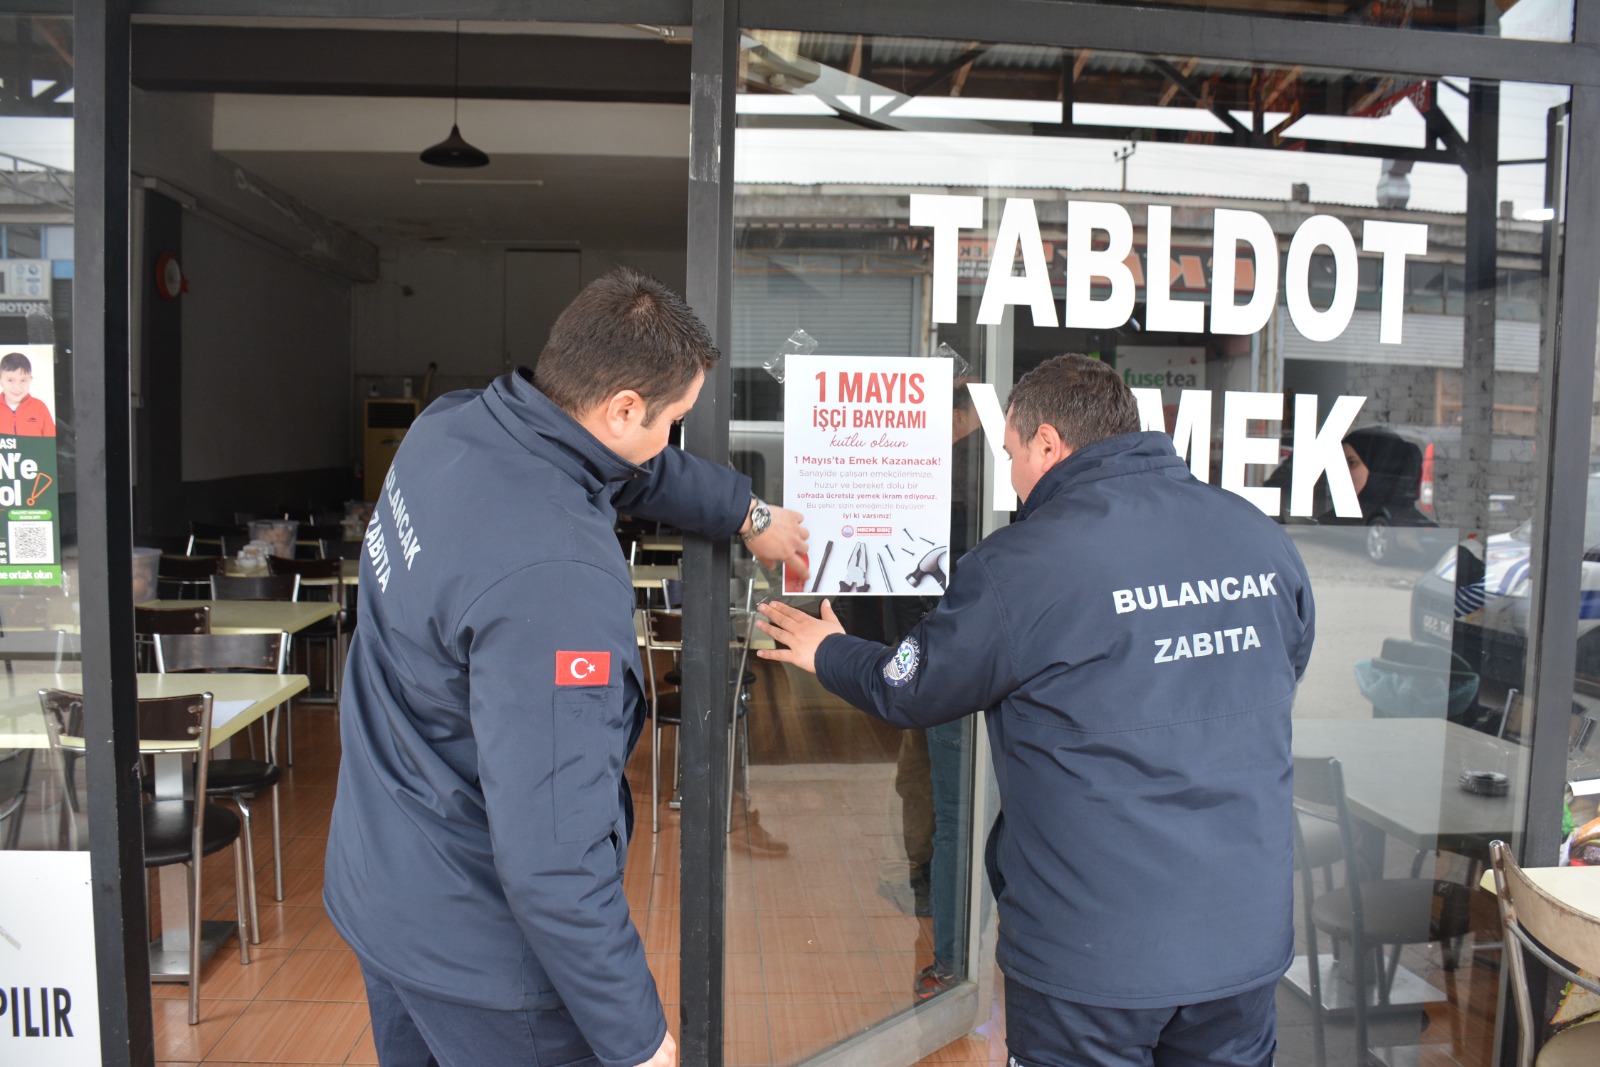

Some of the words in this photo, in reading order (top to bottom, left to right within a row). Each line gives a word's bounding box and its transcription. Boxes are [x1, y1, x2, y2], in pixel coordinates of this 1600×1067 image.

[910, 194, 1428, 345] TABLDOT
[815, 371, 826, 402] 1
[839, 372, 925, 404] MAYIS
[1123, 368, 1196, 387] fusetea
[813, 405, 846, 432] İŞÇİ
[853, 409, 926, 429] BAYRAMI
[830, 433, 866, 448] kutlu
[870, 433, 908, 448] olsun
[967, 383, 1367, 518] YMEK
[794, 456, 799, 464] 1
[849, 456, 878, 465] Emek
[882, 457, 941, 466] Kazanacak!
[799, 469, 837, 479] Sanayide
[840, 470, 868, 479] çalışan
[870, 470, 934, 479] emekçilerimize,
[797, 492, 825, 500] sofrada
[826, 492, 855, 500] ücretsiz
[857, 493, 881, 501] yemek
[814, 481, 837, 489] huzur
[852, 481, 884, 490] bereket
[887, 482, 905, 490] dolu
[907, 482, 918, 490] bir
[386, 464, 421, 571] ULANCAK
[366, 510, 391, 594] ZABITA
[9, 570, 33, 579] ortak
[34, 570, 53, 579] olun
[1112, 573, 1277, 614] BULANCAK
[1154, 625, 1262, 664] ZABITA
